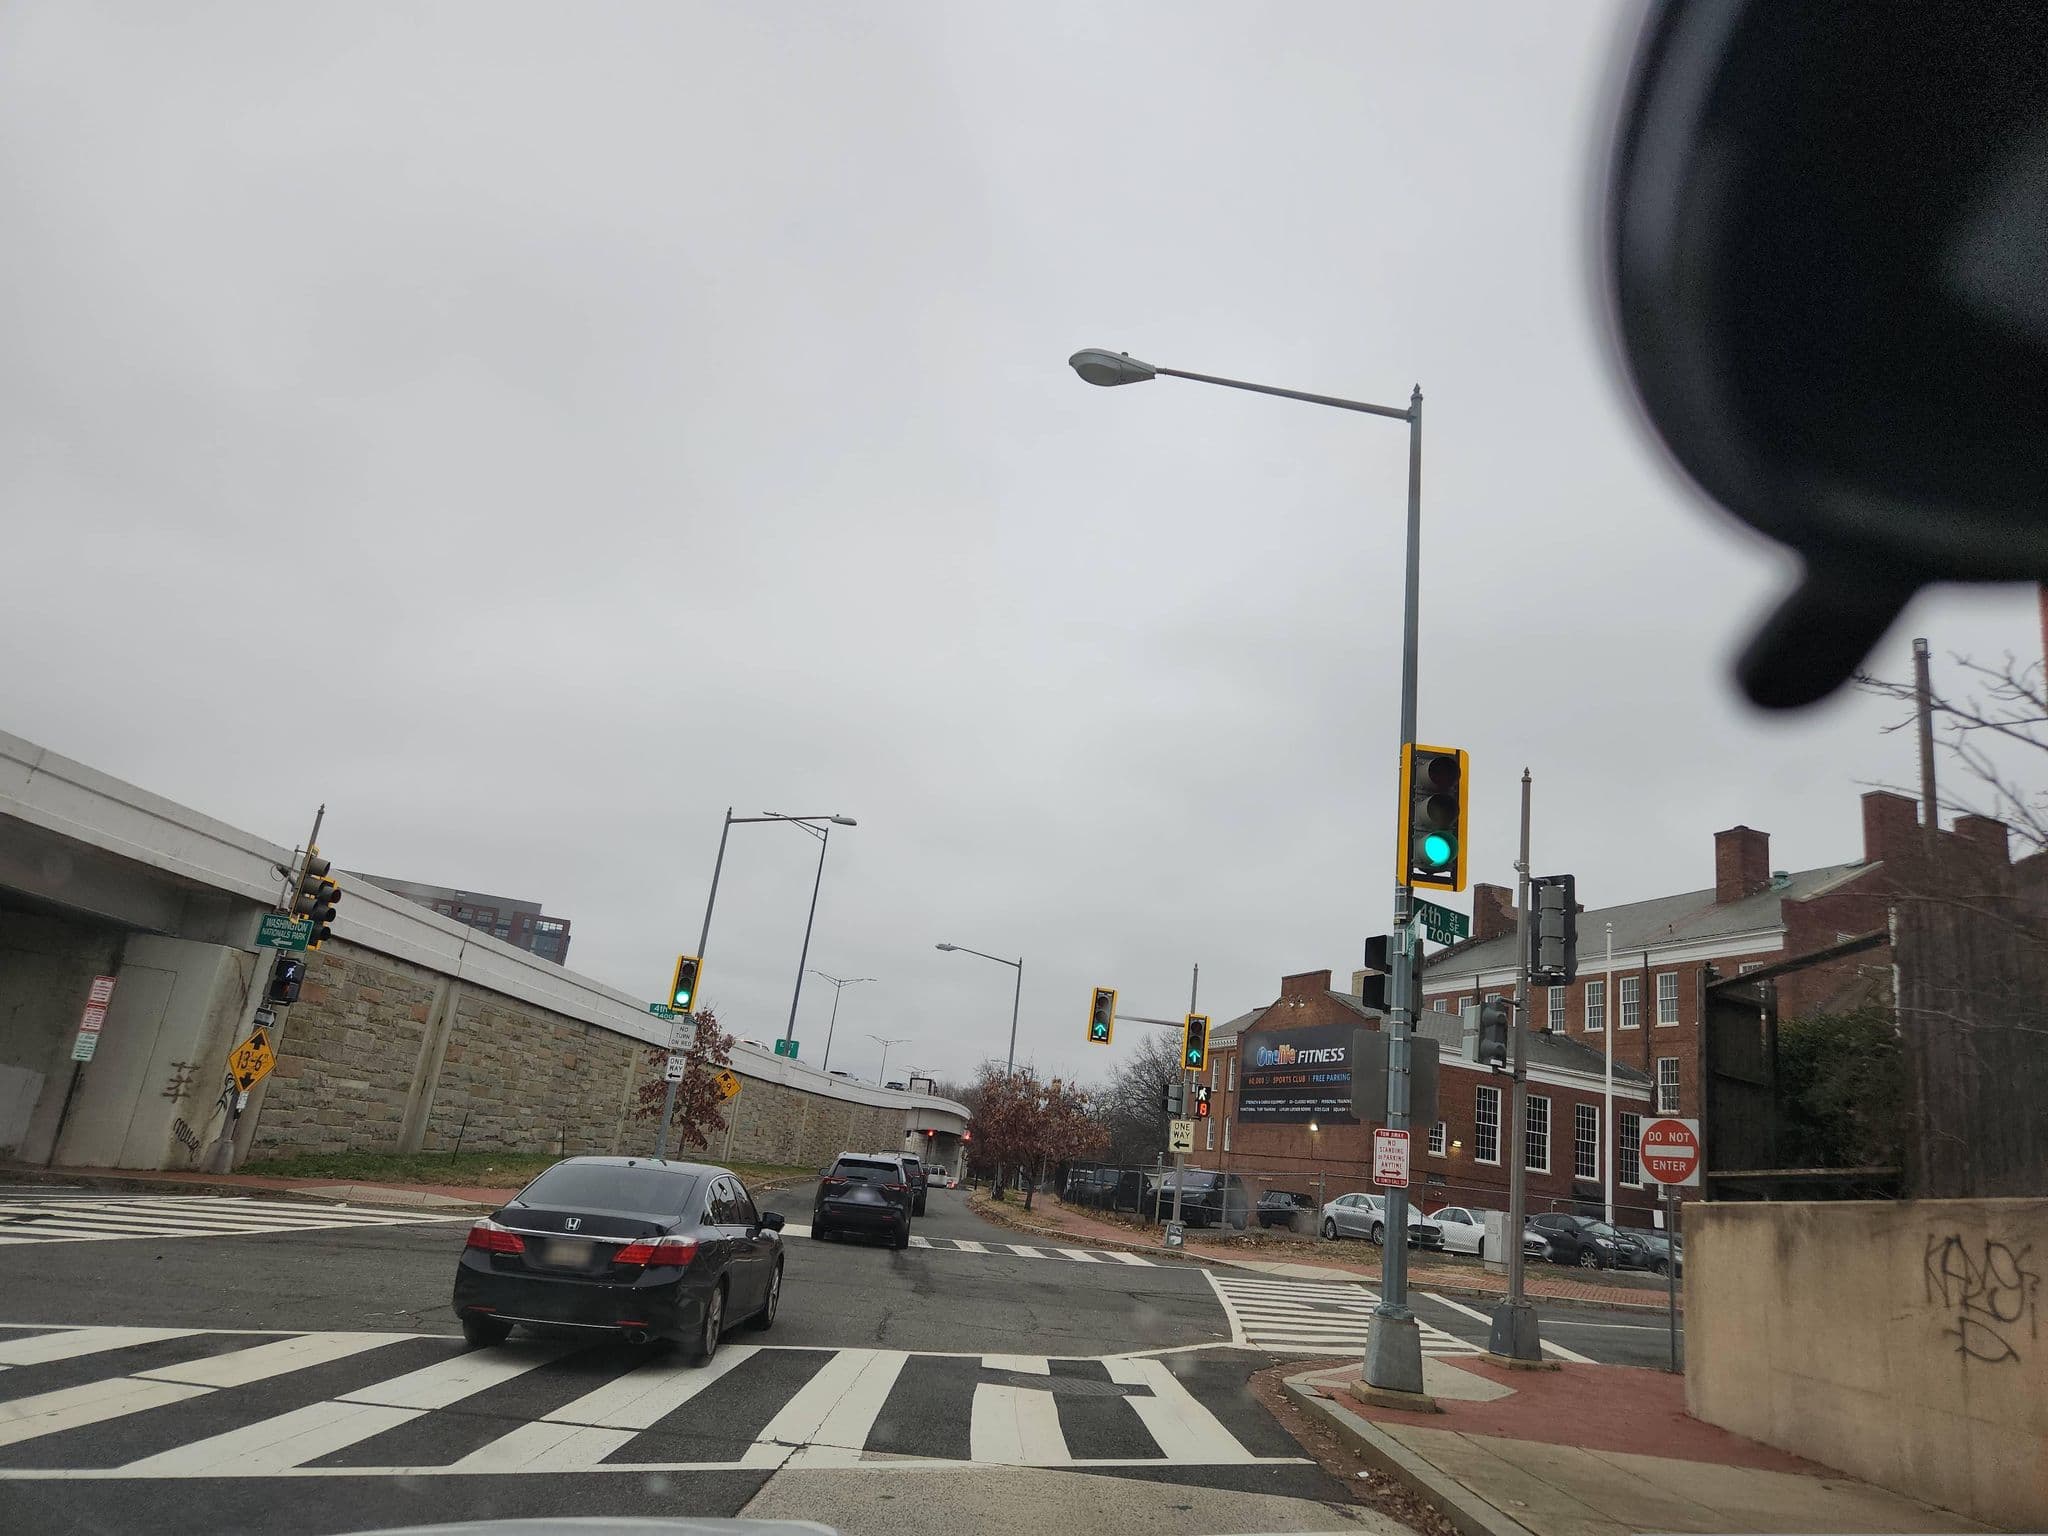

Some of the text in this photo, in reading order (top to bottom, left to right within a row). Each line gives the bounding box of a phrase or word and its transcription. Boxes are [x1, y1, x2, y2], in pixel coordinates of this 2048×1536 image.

[1420, 904, 1458, 926] 4th St
[266, 917, 308, 932] WASHINGTON
[1449, 922, 1460, 934] SE
[1429, 926, 1452, 945] 700
[670, 1057, 684, 1066] ONE
[1297, 1047, 1346, 1064] FITNESS
[669, 1065, 683, 1073] WAY
[1312, 1074, 1326, 1083] FREE
[1326, 1072, 1352, 1082] PARKING
[1174, 1122, 1191, 1131] ONE
[1173, 1130, 1191, 1140] WAY
[1648, 1131, 1690, 1143] DO NOT
[1380, 1146, 1404, 1154] STANDING
[1653, 1160, 1686, 1172] ENTER
